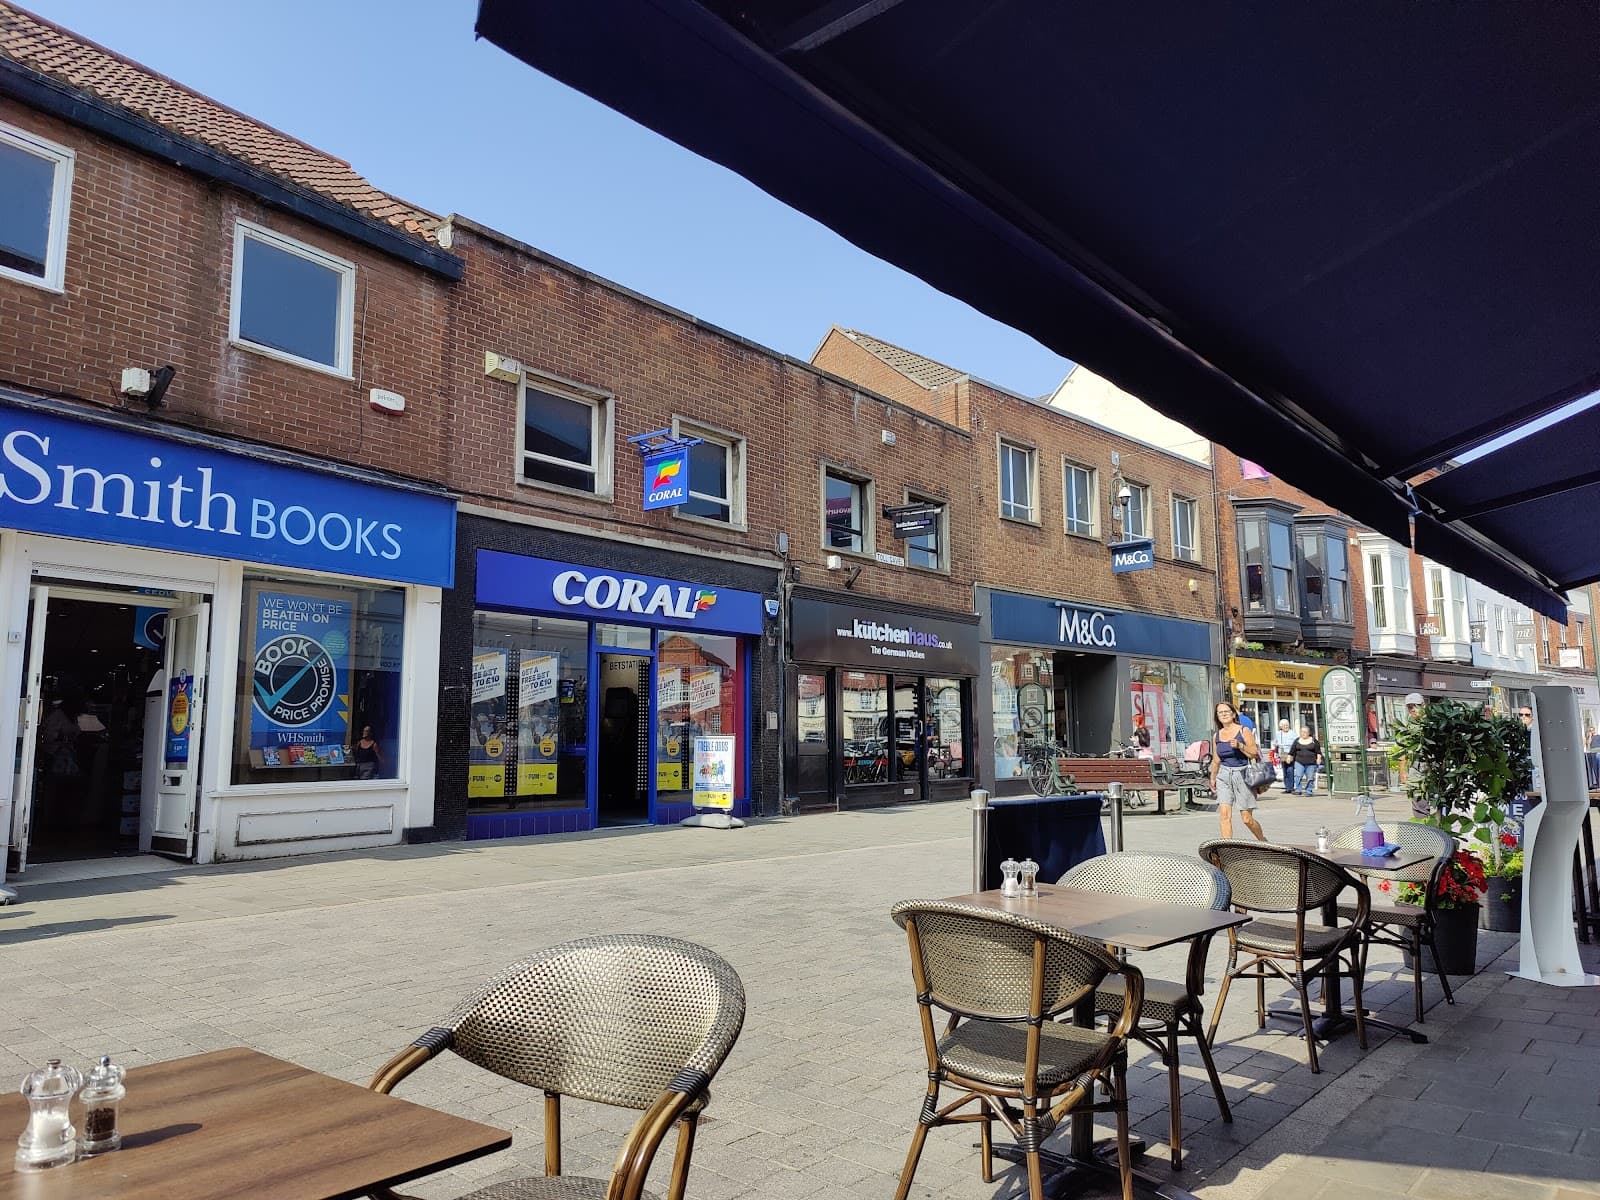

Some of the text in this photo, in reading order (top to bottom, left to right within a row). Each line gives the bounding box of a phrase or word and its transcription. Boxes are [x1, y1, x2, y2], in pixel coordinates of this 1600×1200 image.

[648, 488, 683, 503] CORAL
[250, 498, 402, 560] BOOKS
[552, 571, 697, 618] CORAL
[263, 597, 343, 615] WE WON'T BE
[262, 608, 329, 624] BEATEN ON
[262, 619, 297, 632] PRICE
[255, 638, 312, 675] BOOK
[870, 645, 926, 660] The German Kitchen
[311, 659, 331, 713] PROMISE
[273, 705, 311, 721] PRICE
[277, 732, 324, 743] WHSmith
